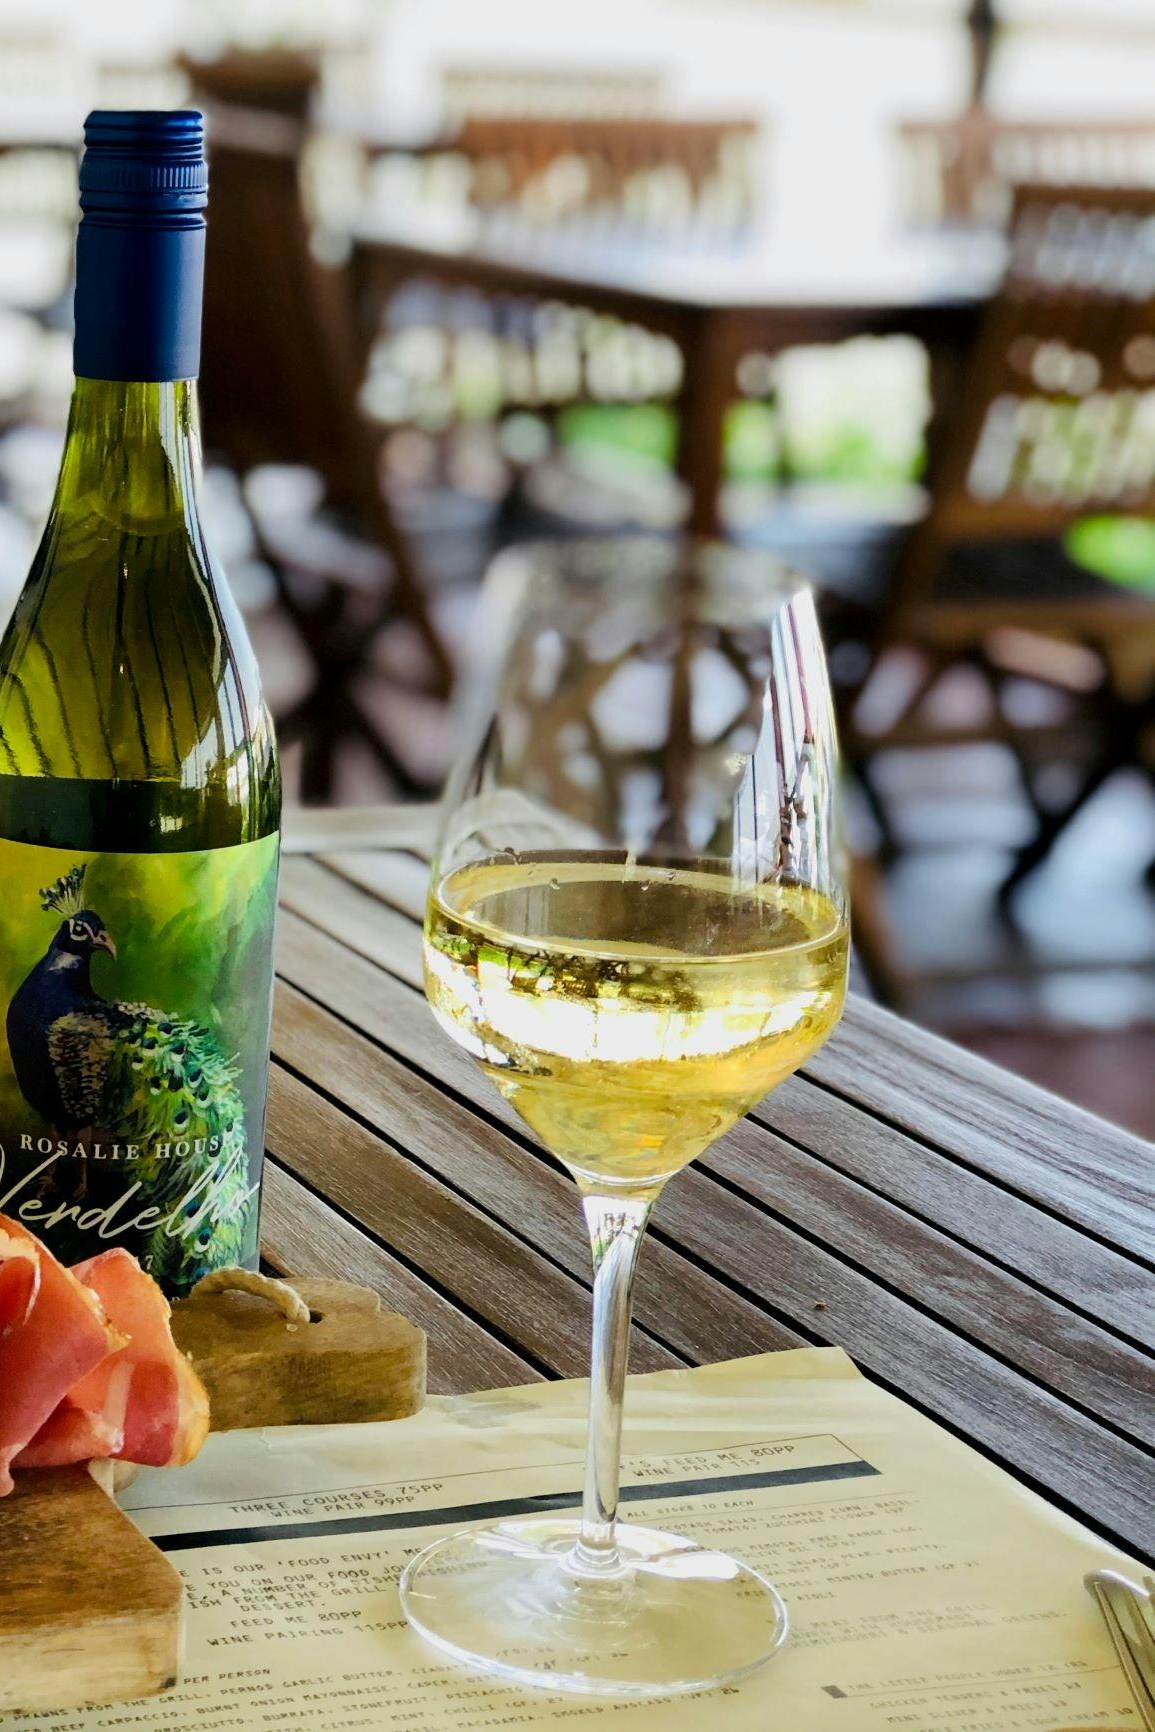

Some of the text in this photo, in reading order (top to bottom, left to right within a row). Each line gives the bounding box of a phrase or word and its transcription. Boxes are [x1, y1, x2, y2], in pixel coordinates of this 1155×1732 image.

[20, 1134, 139, 1160] ROSALIE
[632, 1466, 675, 1478] WINE
[683, 1461, 723, 1472] PAIR
[662, 1455, 708, 1466] FEED
[717, 1452, 742, 1461] ME
[229, 1482, 444, 1514] THREE COURSES 75PP
[271, 1494, 416, 1518] WINE PAIR 99PP
[202, 1567, 223, 1576] IS
[233, 1562, 266, 1574] OUR
[208, 1579, 240, 1592] YOU
[251, 1576, 274, 1587] ON
[283, 1572, 316, 1584] OUR
[328, 1567, 371, 1580] FOOD
[188, 1599, 222, 1610] ISH
[233, 1594, 278, 1605] FROM
[289, 1590, 323, 1600] THE
[331, 1584, 388, 1597] GRILL
[221, 1588, 232, 1597] A
[242, 1582, 306, 1596] NUMBER
[318, 1579, 336, 1589] OF
[350, 1573, 401, 1586] DISHE
[230, 1610, 362, 1629] FEED ME 80PP
[207, 1620, 409, 1647] WINE PAIRING 115PP
[183, 1667, 271, 1685] PER PERSON
[76, 1703, 114, 1715] FROM
[123, 1698, 150, 1708] THE
[282, 1675, 335, 1689] GARLIC
[196, 1702, 241, 1715] BURNT
[249, 1696, 296, 1708] ONION
